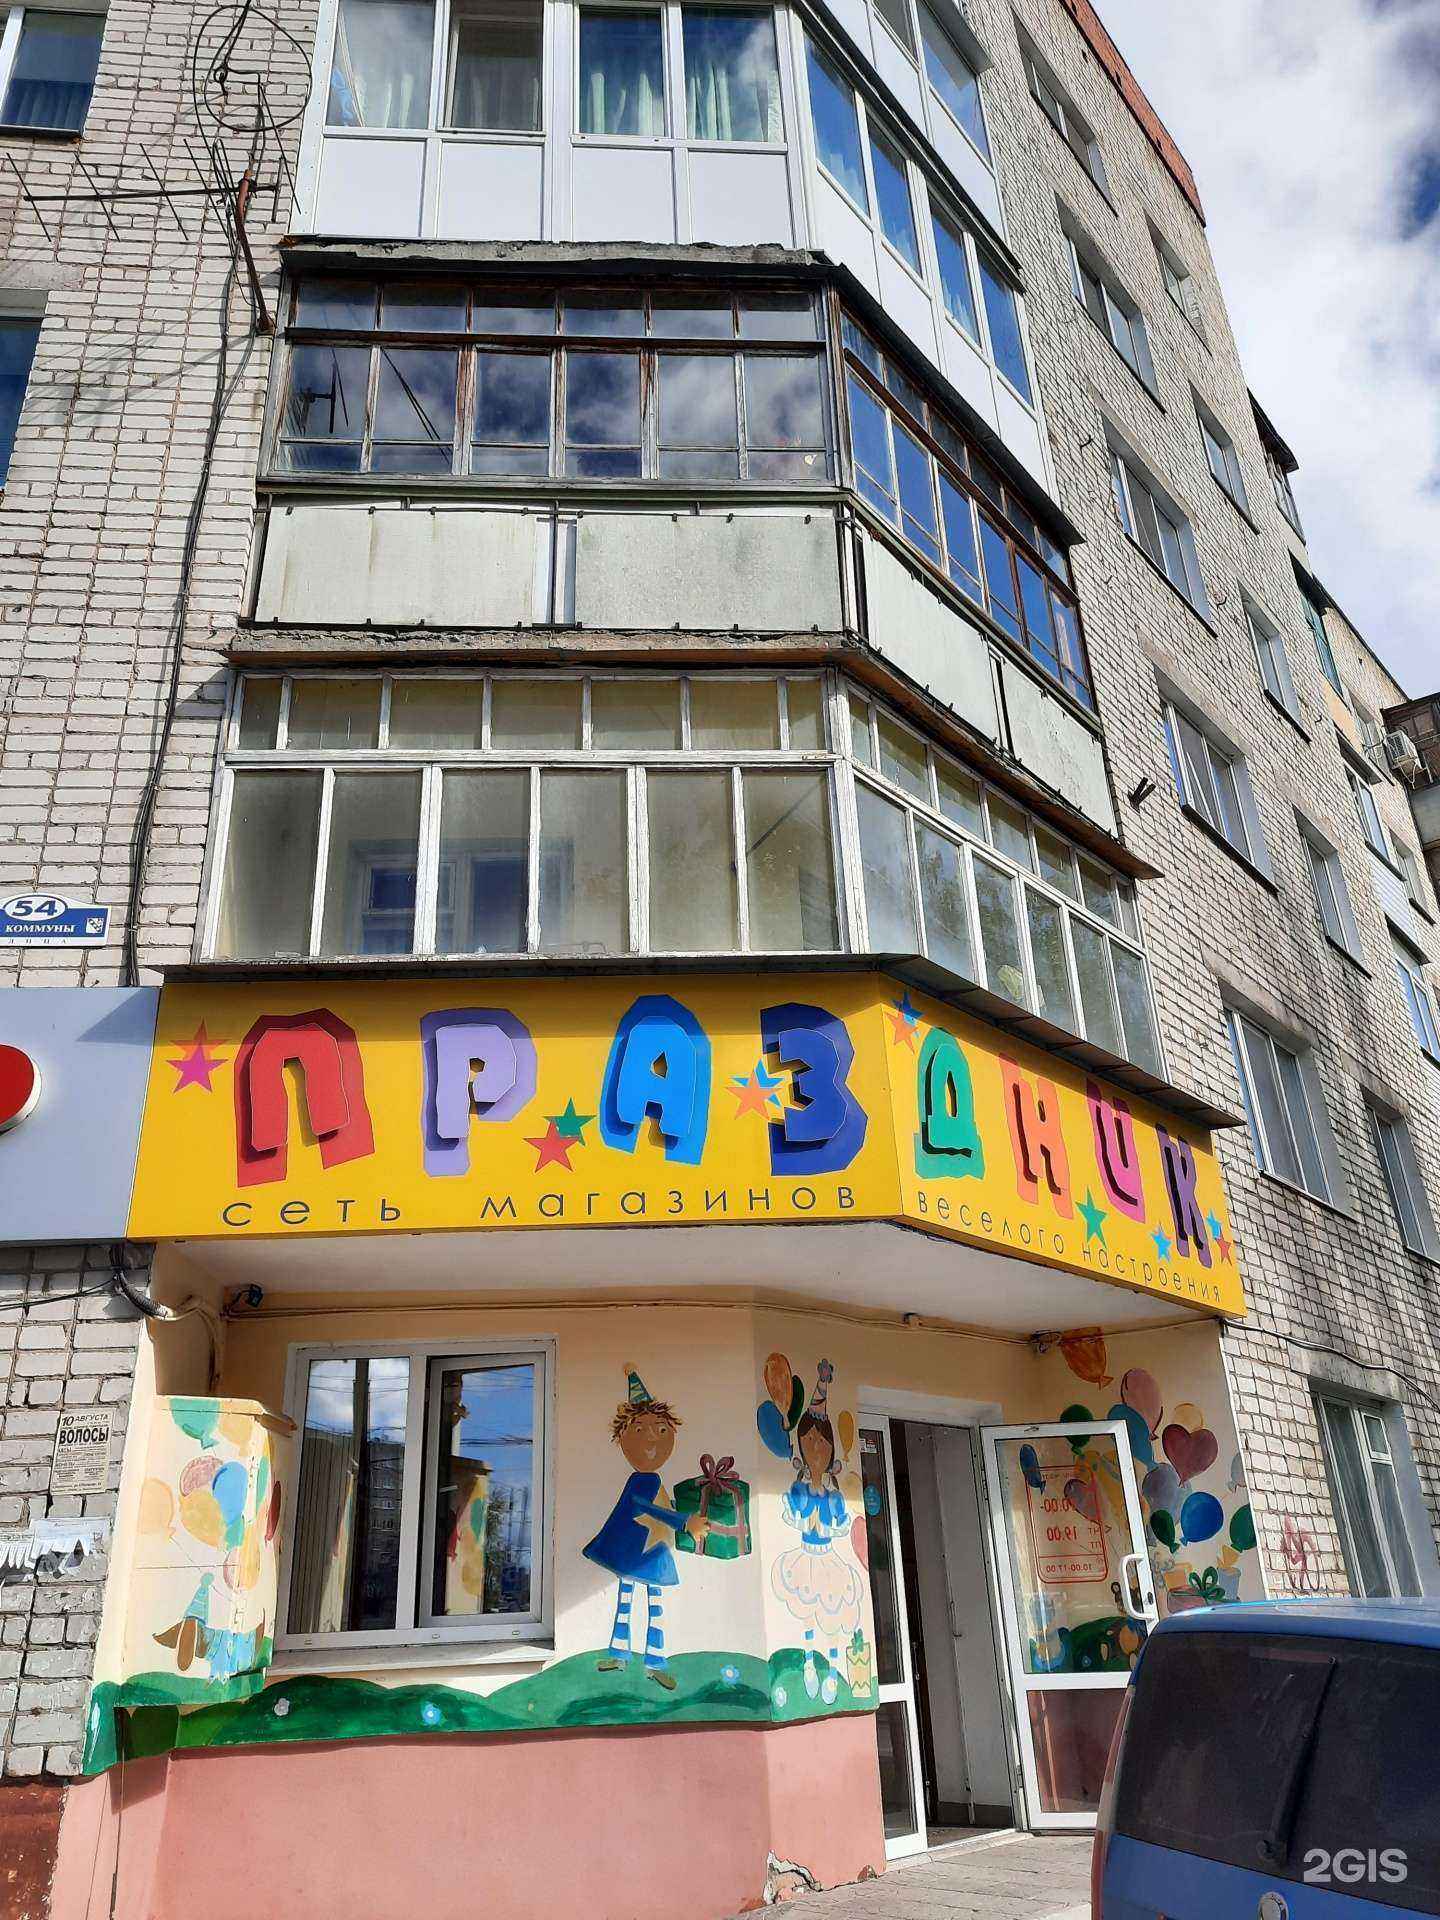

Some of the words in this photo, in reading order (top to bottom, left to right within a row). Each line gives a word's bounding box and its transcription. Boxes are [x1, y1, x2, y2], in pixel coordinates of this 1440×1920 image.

[12, 900, 58, 916] 54
[5, 924, 77, 933] КОММУНЫ
[233, 993, 1213, 1269] ПРАЗДНИК
[221, 1197, 402, 1228] сеть
[480, 1185, 856, 1219] магазинов
[917, 1190, 1065, 1256] веселого
[1082, 1246, 1222, 1303] настроения
[62, 1416, 75, 1427] 10
[76, 1414, 108, 1422] АВГУСТА
[59, 1427, 109, 1444] ВОЛОСЫ
